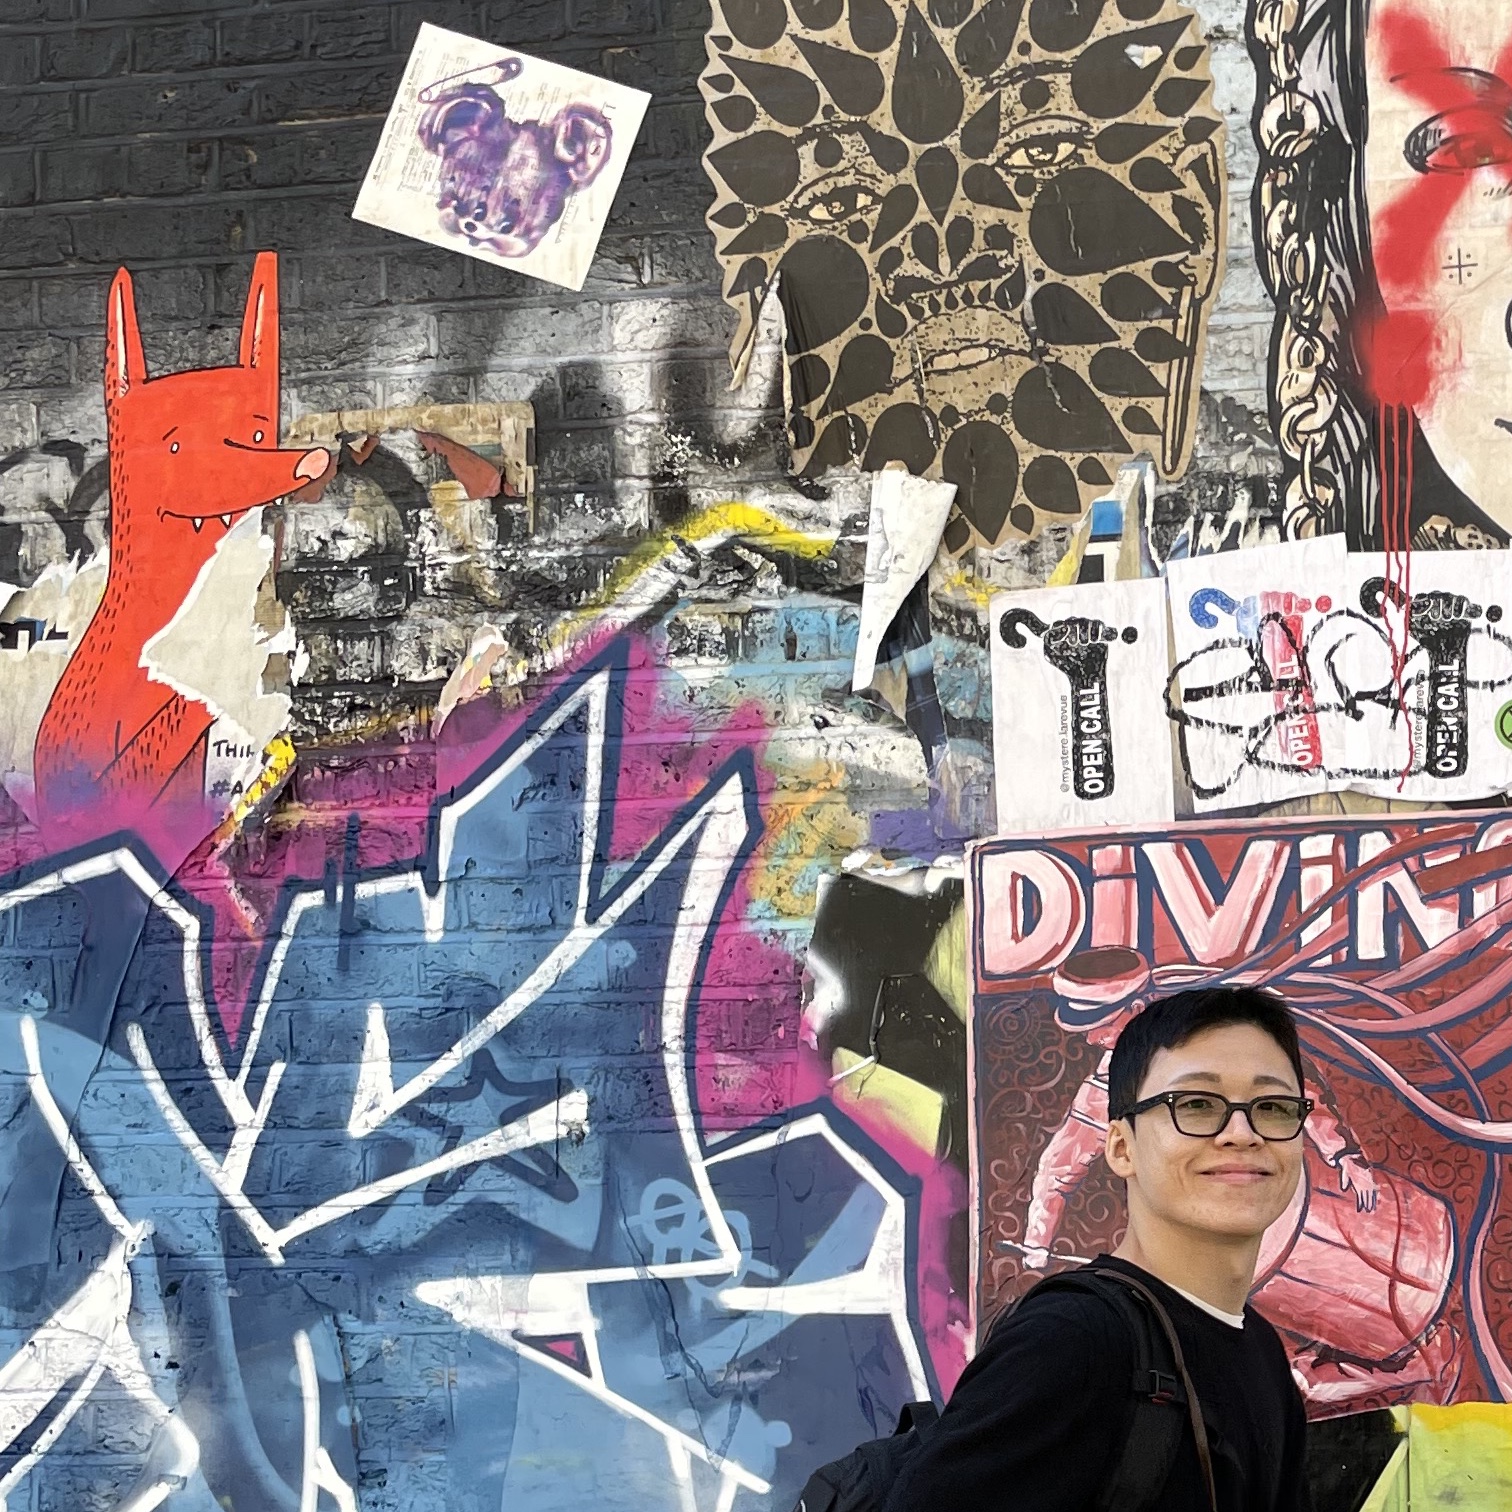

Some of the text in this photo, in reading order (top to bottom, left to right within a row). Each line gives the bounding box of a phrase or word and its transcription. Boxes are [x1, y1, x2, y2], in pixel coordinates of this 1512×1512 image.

[1278, 654, 1304, 707] CLL
[1436, 658, 1460, 772] OPEN CALL
[1058, 694, 1072, 793] @mystere.larevue
[1079, 681, 1105, 794] OPEN CALL
